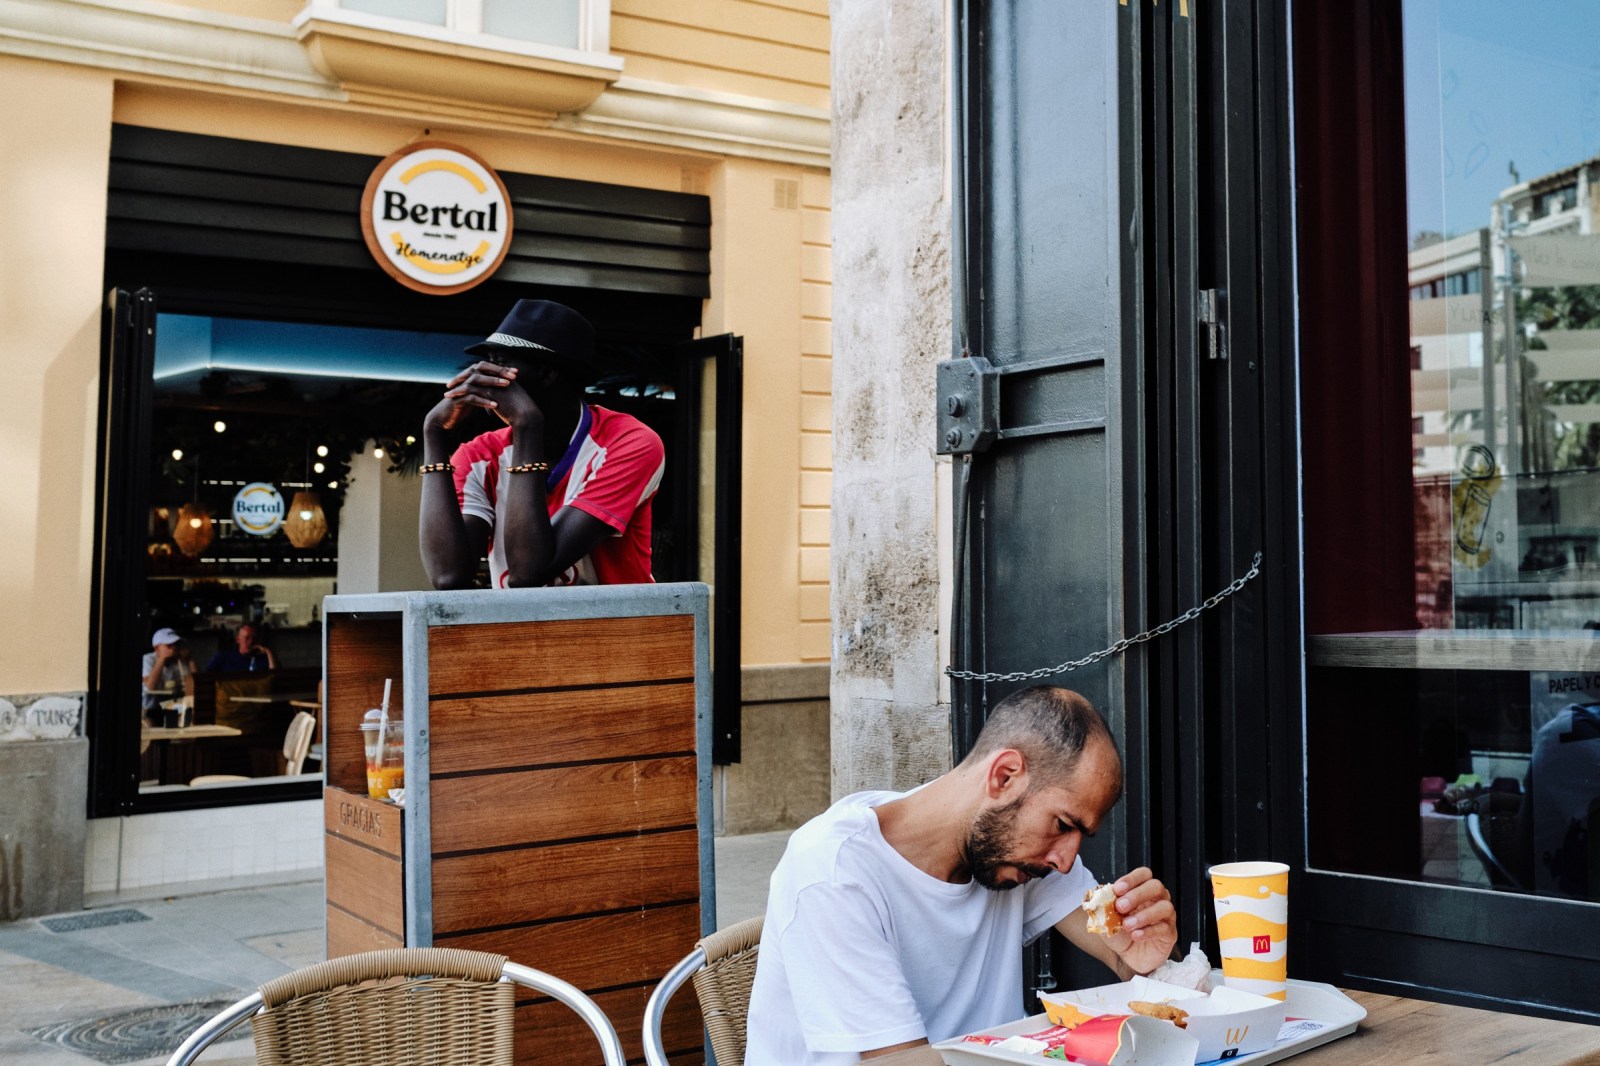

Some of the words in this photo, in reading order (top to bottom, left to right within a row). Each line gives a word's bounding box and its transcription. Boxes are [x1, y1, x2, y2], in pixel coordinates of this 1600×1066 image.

[382, 190, 498, 232] Bertal
[396, 242, 484, 268] Homenatge
[236, 500, 281, 513] Bertal
[1549, 677, 1584, 693] PAPEL
[1585, 675, 1593, 690] Y
[339, 801, 382, 838] GRACIAS
